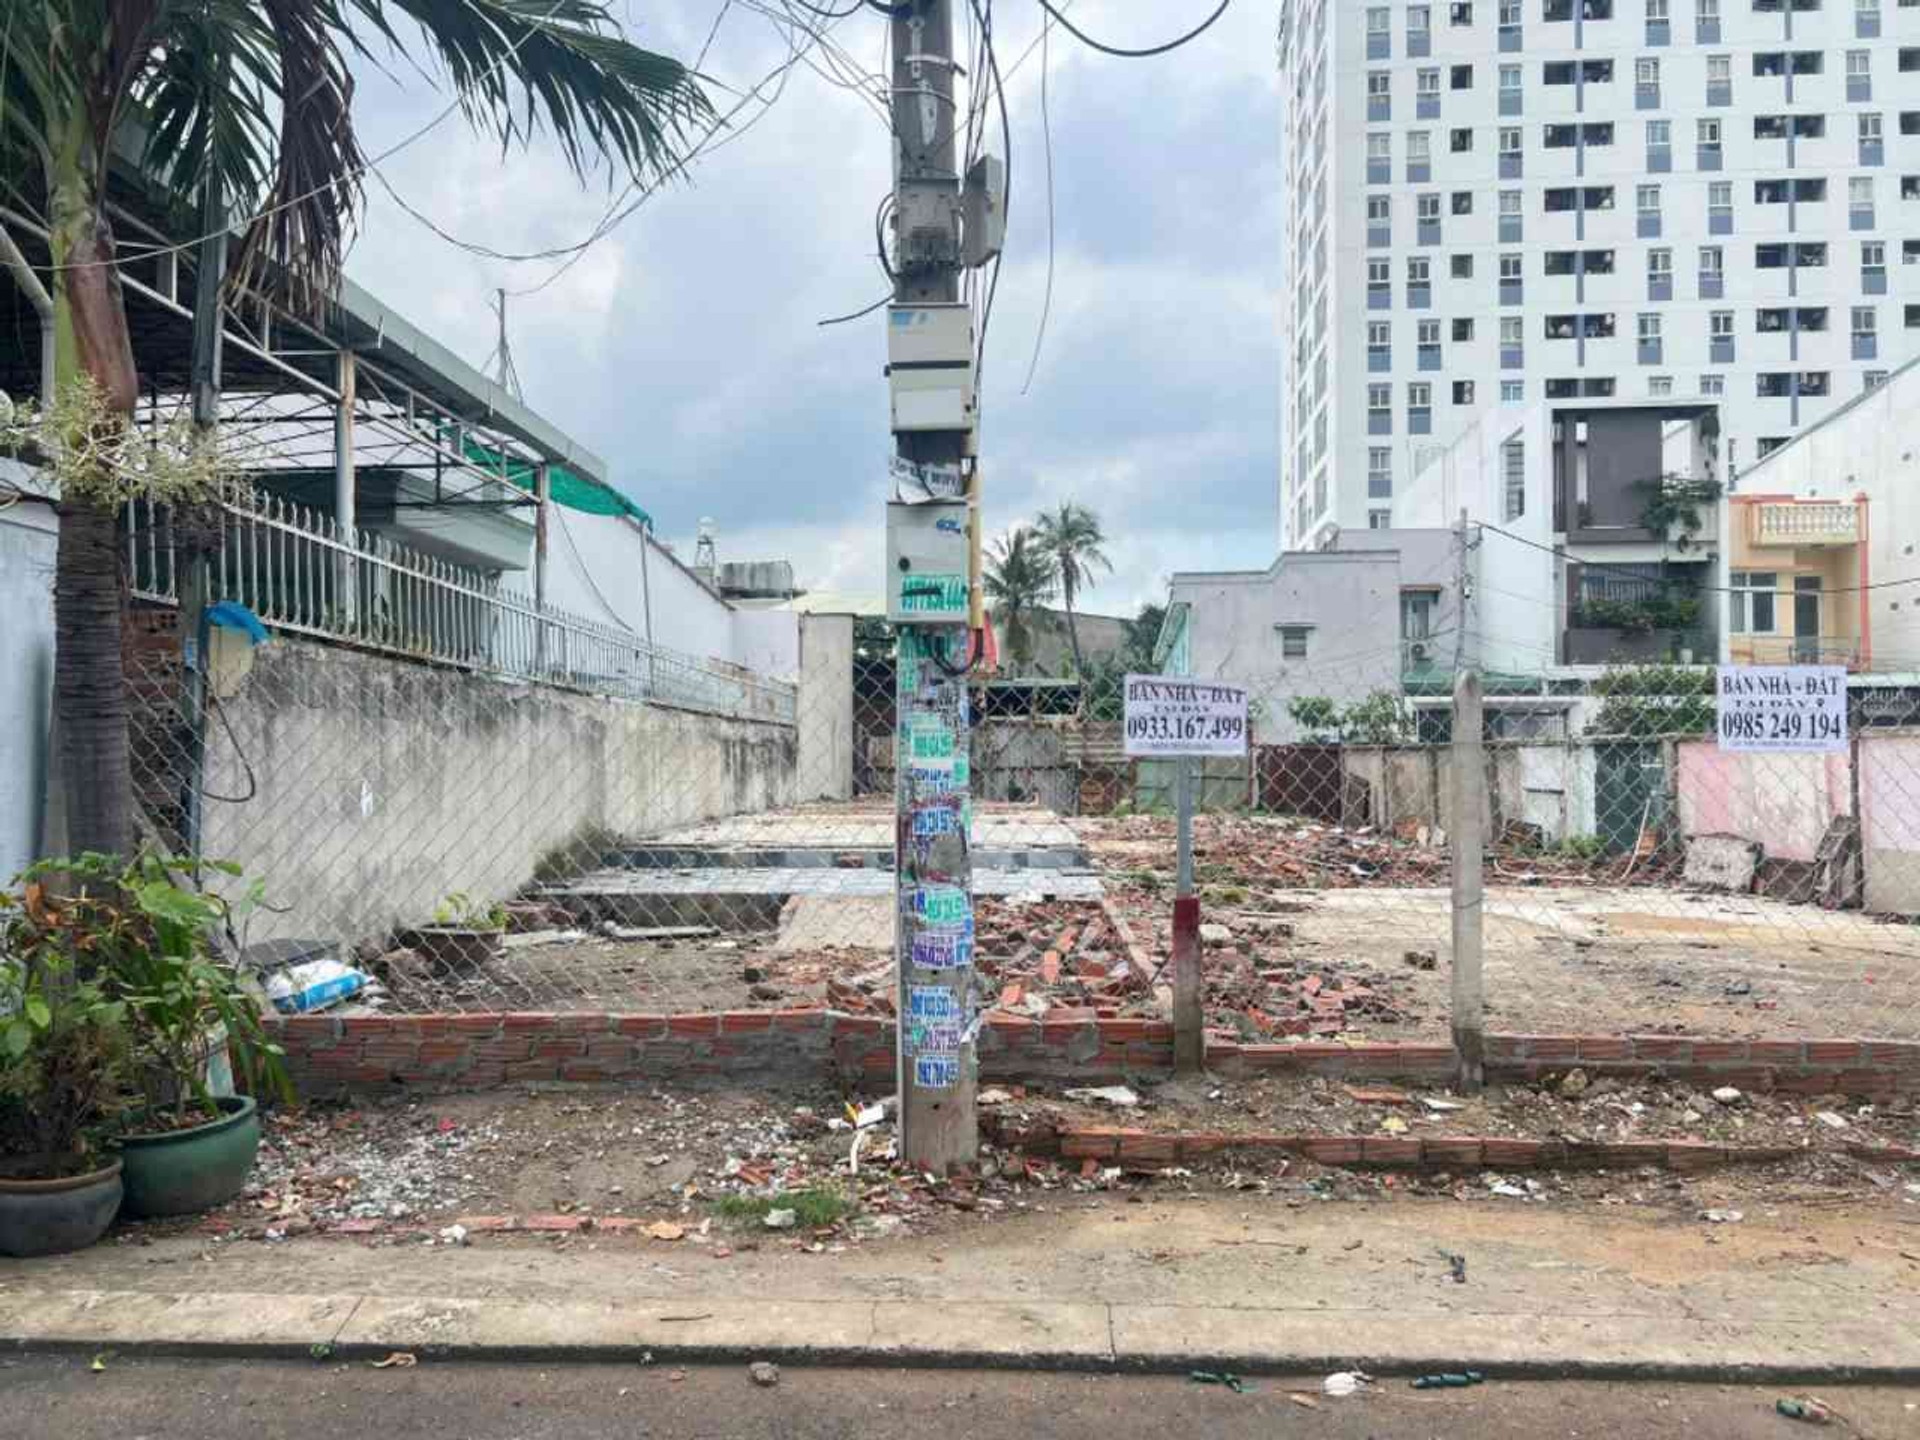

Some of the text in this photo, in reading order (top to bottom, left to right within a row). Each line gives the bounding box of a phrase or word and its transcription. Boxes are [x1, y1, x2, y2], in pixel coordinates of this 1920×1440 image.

[1127, 716, 1243, 740] 0933.167.499
[1722, 711, 1842, 739] 0985 249 194
